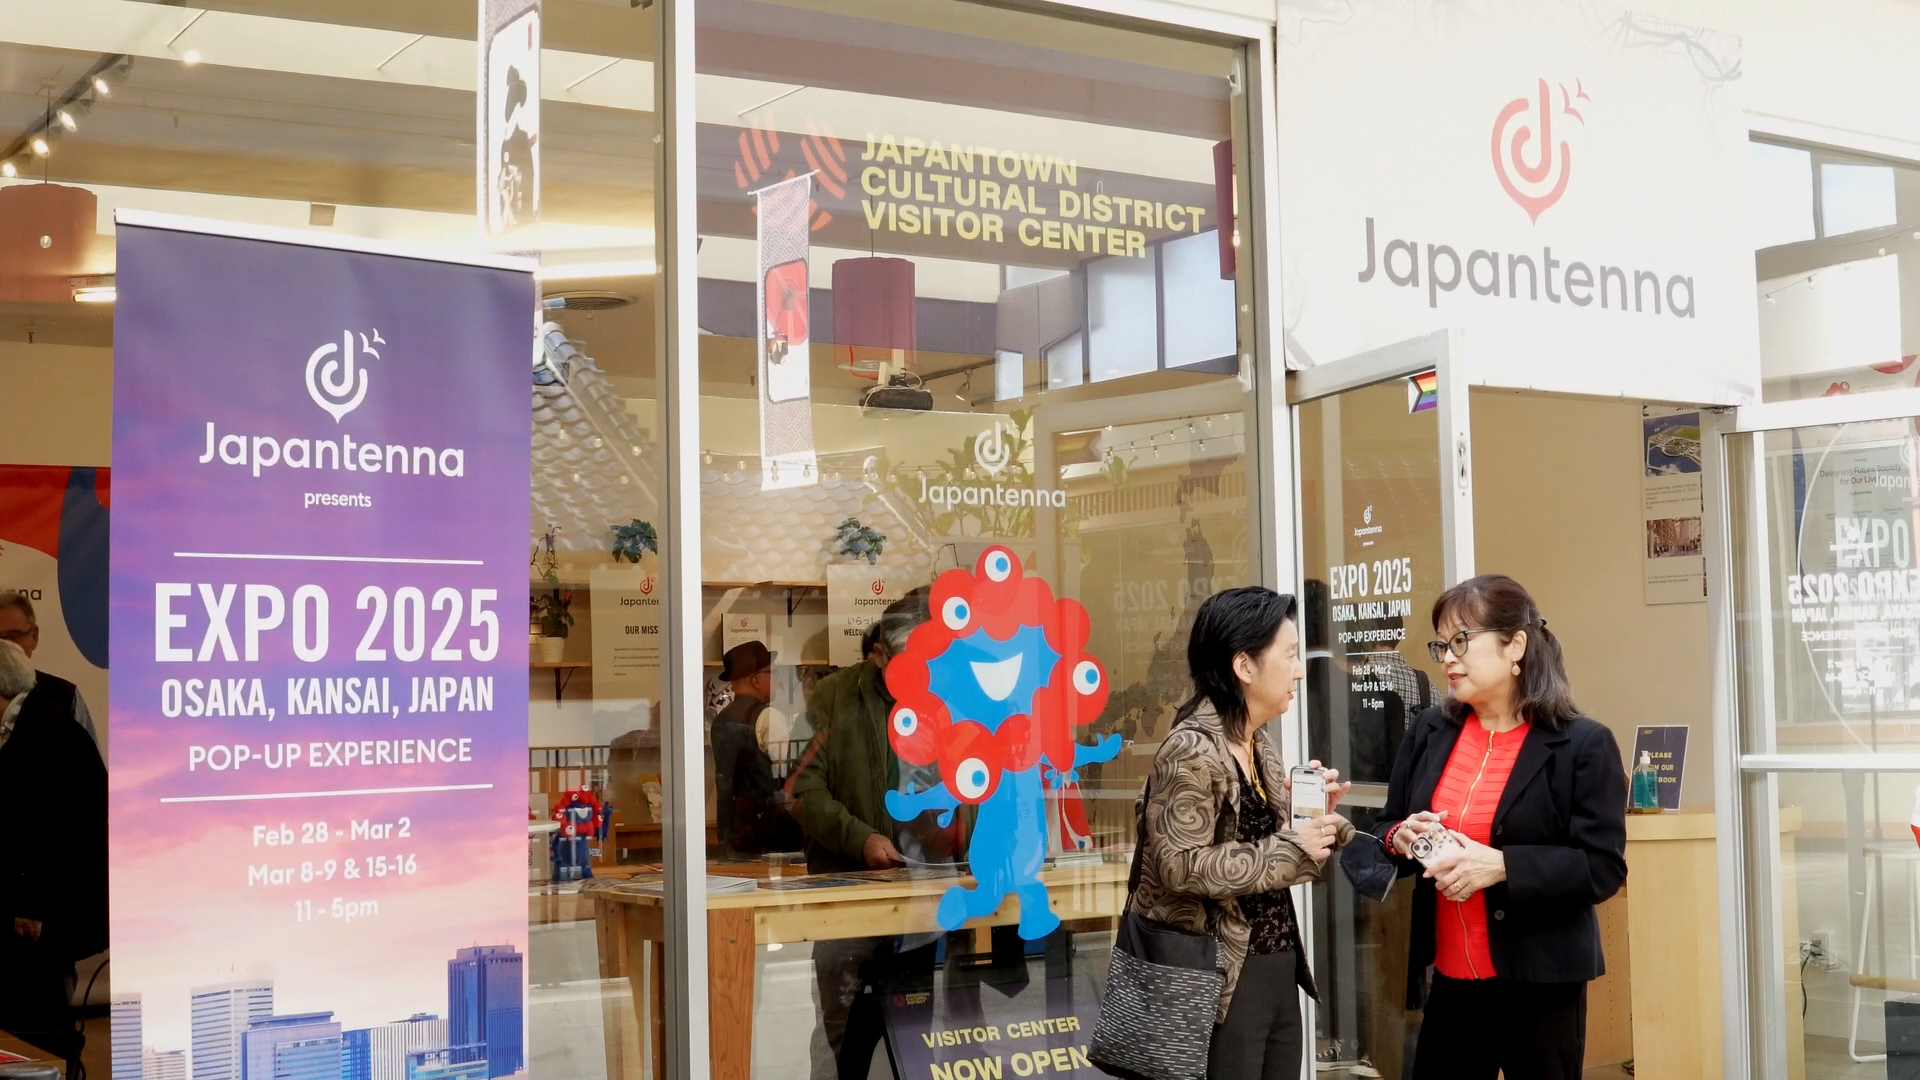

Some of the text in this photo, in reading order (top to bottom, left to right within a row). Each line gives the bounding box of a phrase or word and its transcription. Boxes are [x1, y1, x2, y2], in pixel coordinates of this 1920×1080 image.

[861, 133, 1077, 186] JAPANTOWN
[861, 166, 1205, 234] CULTURAL DISTRICT
[861, 200, 1146, 258] VISITOR CENTER
[1358, 216, 1695, 319] Japantenna
[199, 421, 465, 478] Japantenna
[1820, 468, 1853, 479] Designing
[1876, 463, 1903, 473] Society
[1840, 475, 1879, 485] for Our Live
[304, 491, 372, 508] presents
[918, 477, 1067, 510] Japantenna
[1353, 524, 1382, 537] Japantenna
[1835, 517, 1910, 568] EXPO
[1330, 557, 1412, 600] EXPO 2025
[853, 597, 898, 607] Japantenn
[1332, 598, 1411, 623] OSAKA, KANSAI, JAPAN
[154, 582, 500, 664] EXPO 2025
[625, 625, 639, 635] OUR
[1338, 628, 1406, 644] POP-UP EXPERIENCE
[1352, 666, 1362, 676] Feb
[1363, 665, 1370, 675] 28
[1375, 665, 1386, 675] Mar
[1387, 664, 1391, 674] 2
[161, 676, 494, 722] OSAKA, KANSAI, JAPAN
[1352, 682, 1363, 692] Mar
[1363, 682, 1373, 692] 8-9
[1371, 698, 1384, 709] 5pm
[188, 738, 472, 771] POP-UP EXPERIENCE
[252, 823, 295, 848] Feb
[301, 821, 330, 844] 28
[350, 819, 394, 843] Mar
[396, 817, 411, 840] 2
[247, 853, 417, 887] Mar 8-9 & 15-16
[295, 900, 312, 922] 11
[331, 898, 379, 924] 5pm
[921, 1016, 1080, 1049] VISITOR CENTER
[930, 1045, 1093, 1080] NOW OPEN
